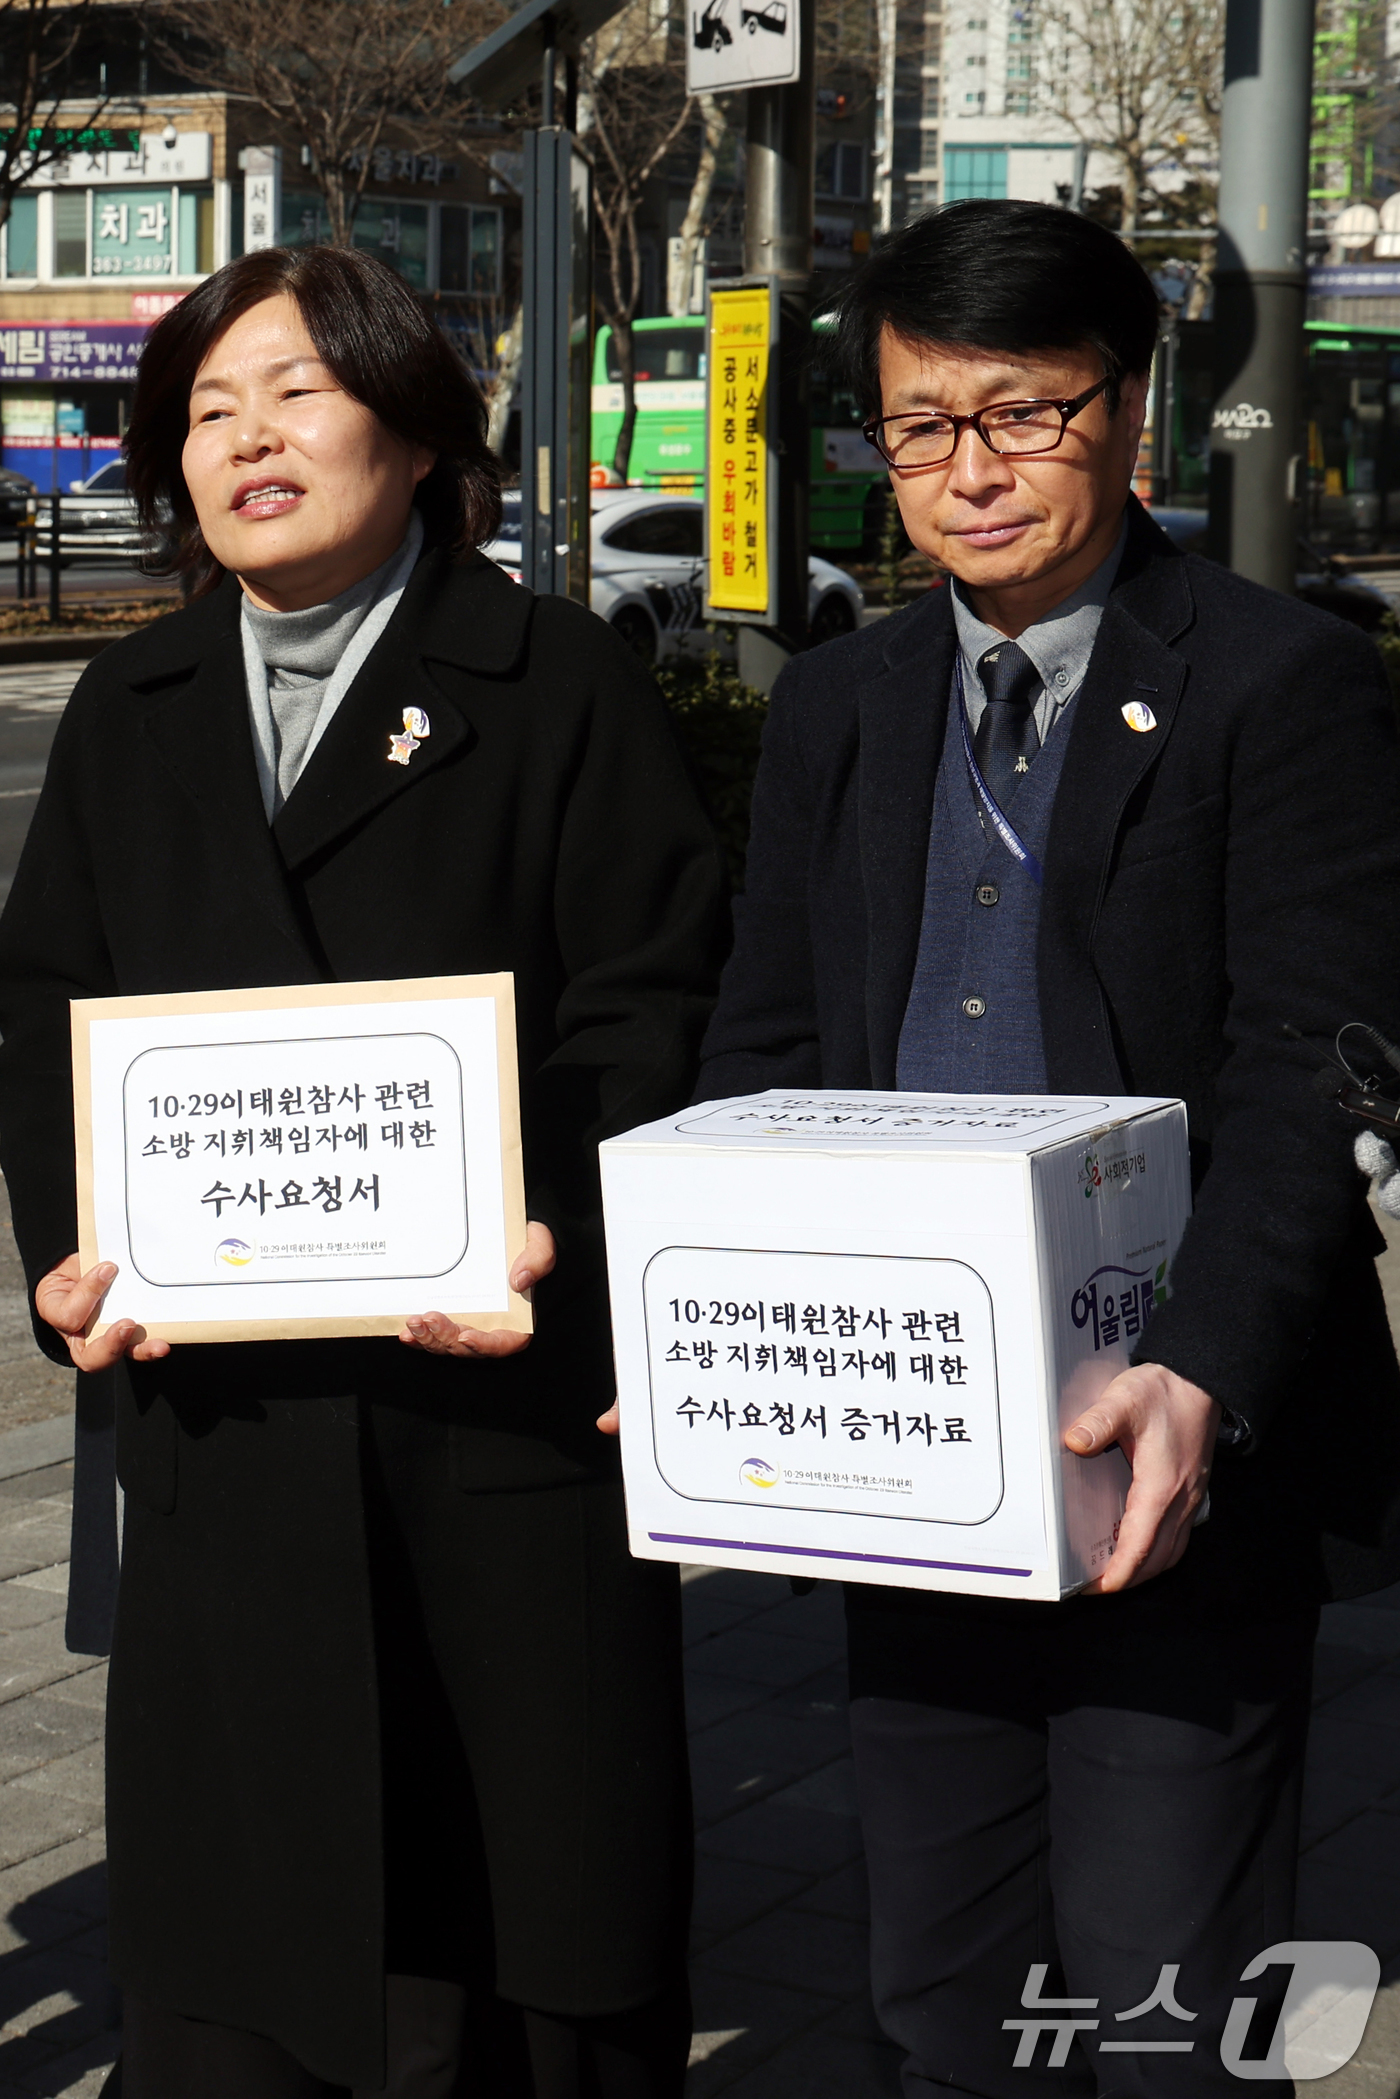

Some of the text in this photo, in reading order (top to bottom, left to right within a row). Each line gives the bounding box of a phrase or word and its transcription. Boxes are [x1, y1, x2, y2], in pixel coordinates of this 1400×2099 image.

[100, 202, 168, 244] 치과
[723, 356, 737, 444] 공사중
[744, 354, 759, 579] 서소문고가 철거
[149, 1079, 434, 1119] 10·29이태원참사 관련
[142, 1119, 437, 1160] 소방 지휘책임자에 대한
[1104, 1152, 1146, 1183] 사회적기업
[200, 1173, 381, 1218] 수사요청서
[669, 1298, 965, 1344] 10·29이태원참사 관련
[1071, 1282, 1140, 1352] 어울림
[665, 1339, 969, 1385] 소방 지휘책임자에 대한
[676, 1395, 973, 1448] 수사요청서 증거자료
